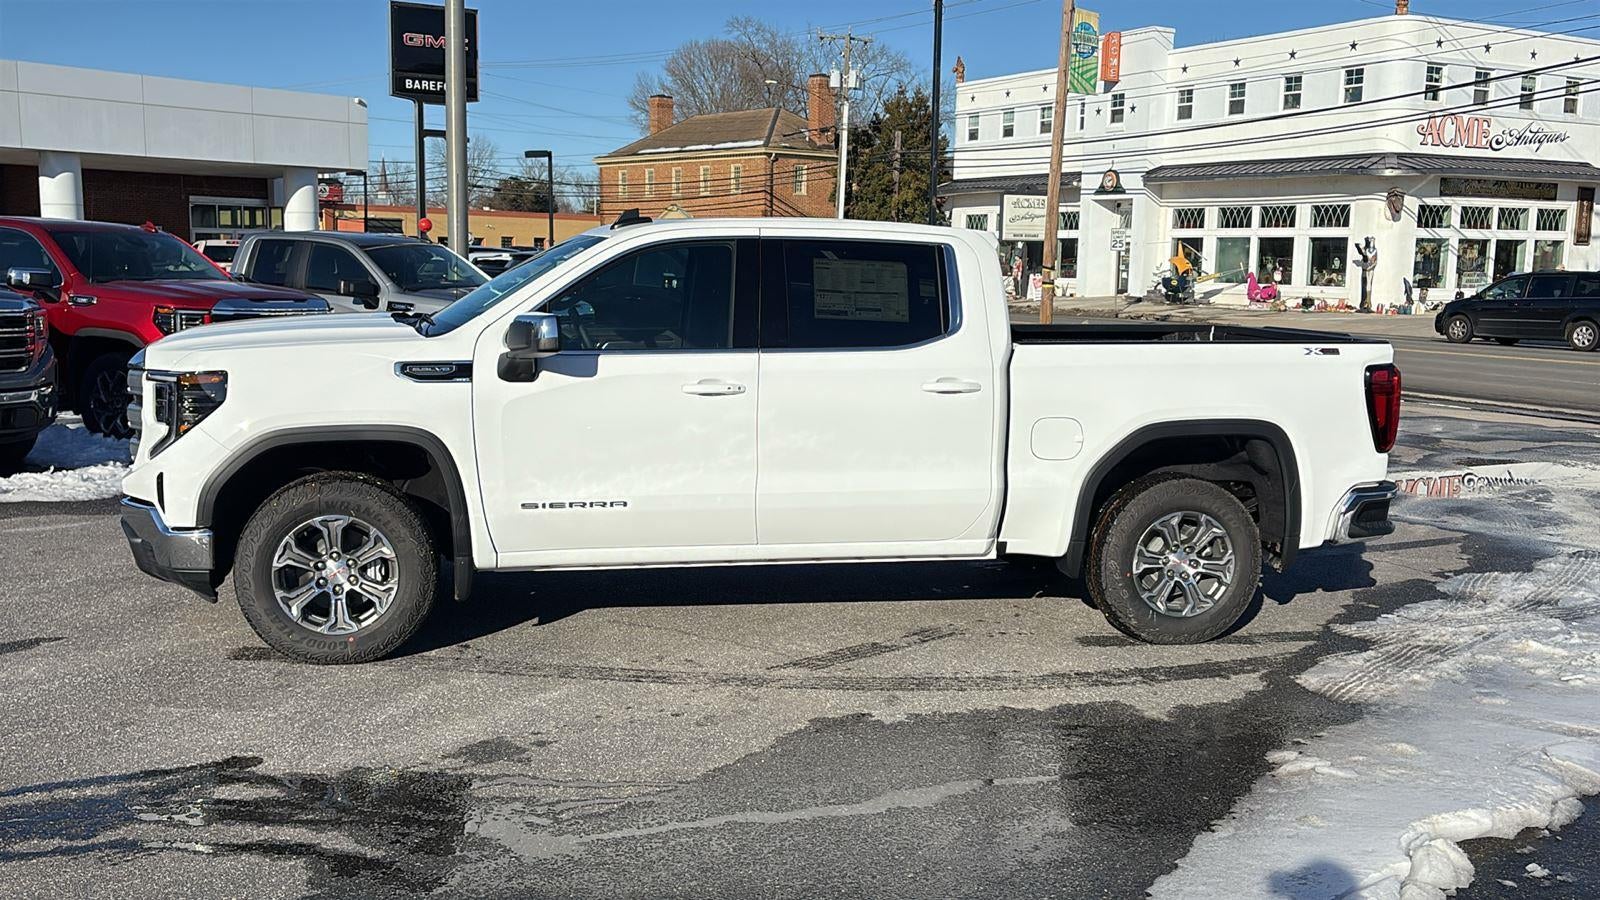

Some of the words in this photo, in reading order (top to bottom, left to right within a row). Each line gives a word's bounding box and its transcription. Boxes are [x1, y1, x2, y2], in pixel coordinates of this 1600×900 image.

[403, 32, 468, 51] GM
[1416, 113, 1492, 149] ACME
[1507, 121, 1570, 152] Antiques
[1112, 239, 1124, 248] 25
[521, 500, 628, 510] SIERRA
